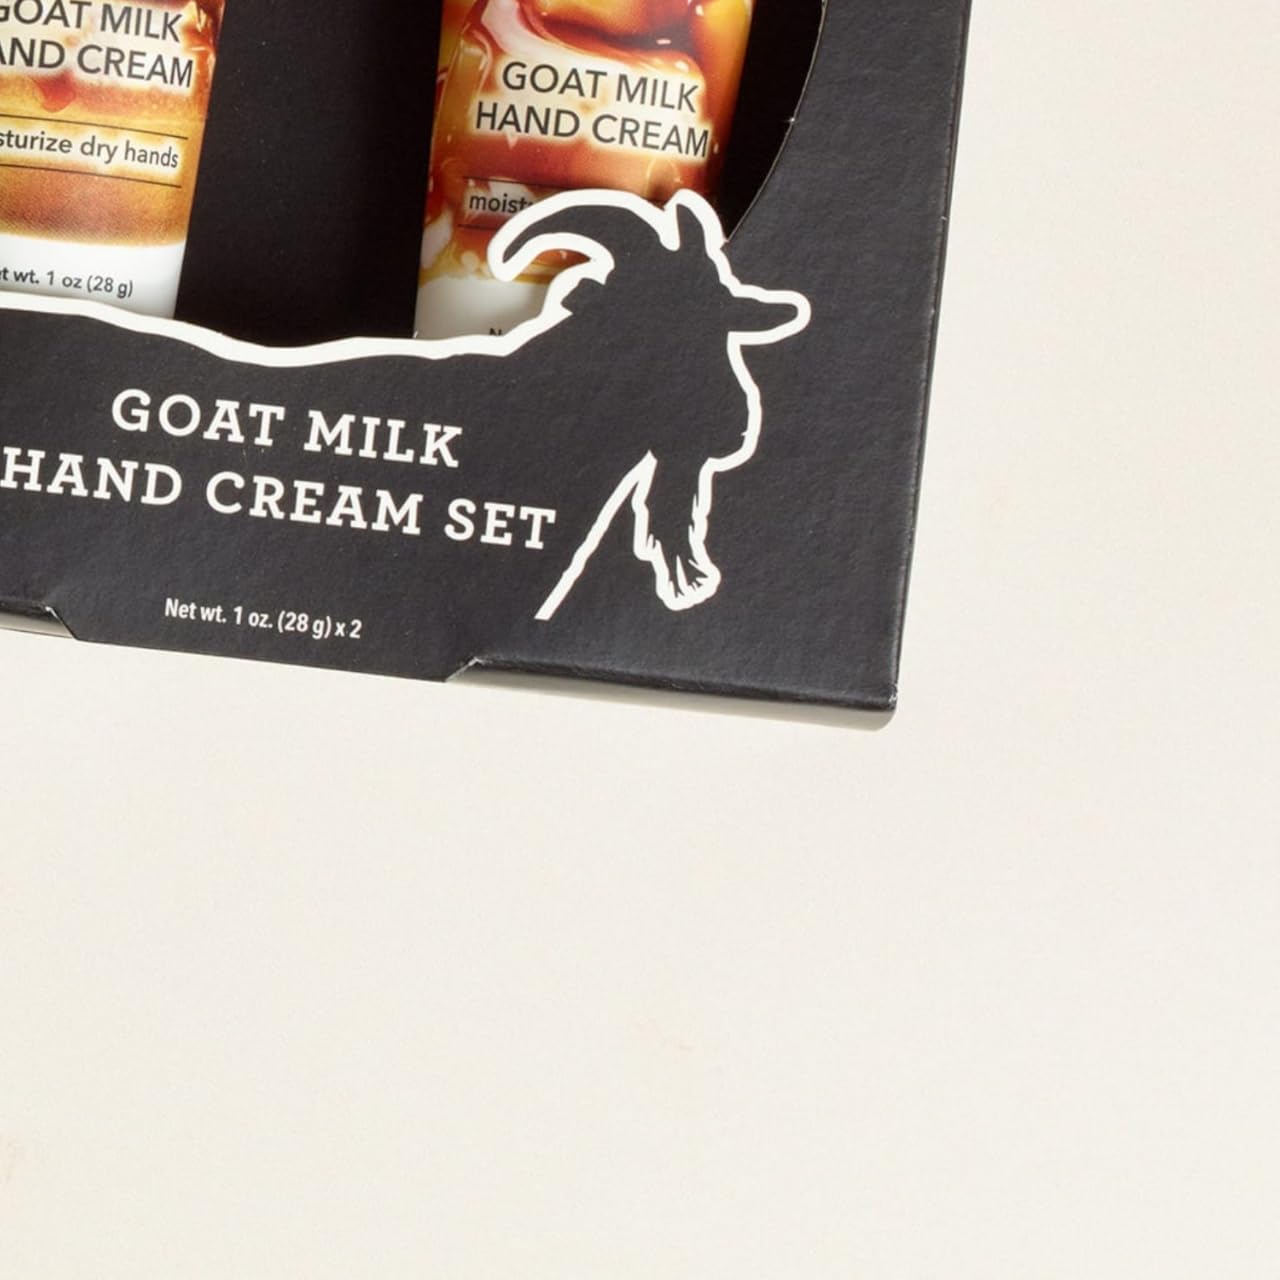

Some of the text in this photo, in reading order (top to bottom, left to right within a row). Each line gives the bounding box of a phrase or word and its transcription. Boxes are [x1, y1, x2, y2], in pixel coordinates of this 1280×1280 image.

[99, 3, 184, 43] MILK
[77, 44, 194, 89] CREAM
[502, 61, 700, 113] GOAT MILK
[80, 135, 119, 165] dry
[123, 140, 179, 169] hands
[475, 101, 710, 158] HAND CREAM
[13, 270, 40, 285] wt.
[46, 270, 55, 286] 1
[62, 276, 82, 289] oz
[87, 275, 114, 293] (28
[117, 280, 133, 299] g)
[111, 388, 463, 469] GOAT MILK
[0, 445, 557, 551] HAND CREAM SET
[164, 597, 197, 620] Net
[200, 605, 227, 623] wt.
[233, 606, 243, 625] 1
[248, 612, 273, 629] oz.
[334, 622, 345, 637] x
[349, 619, 362, 639] 2
